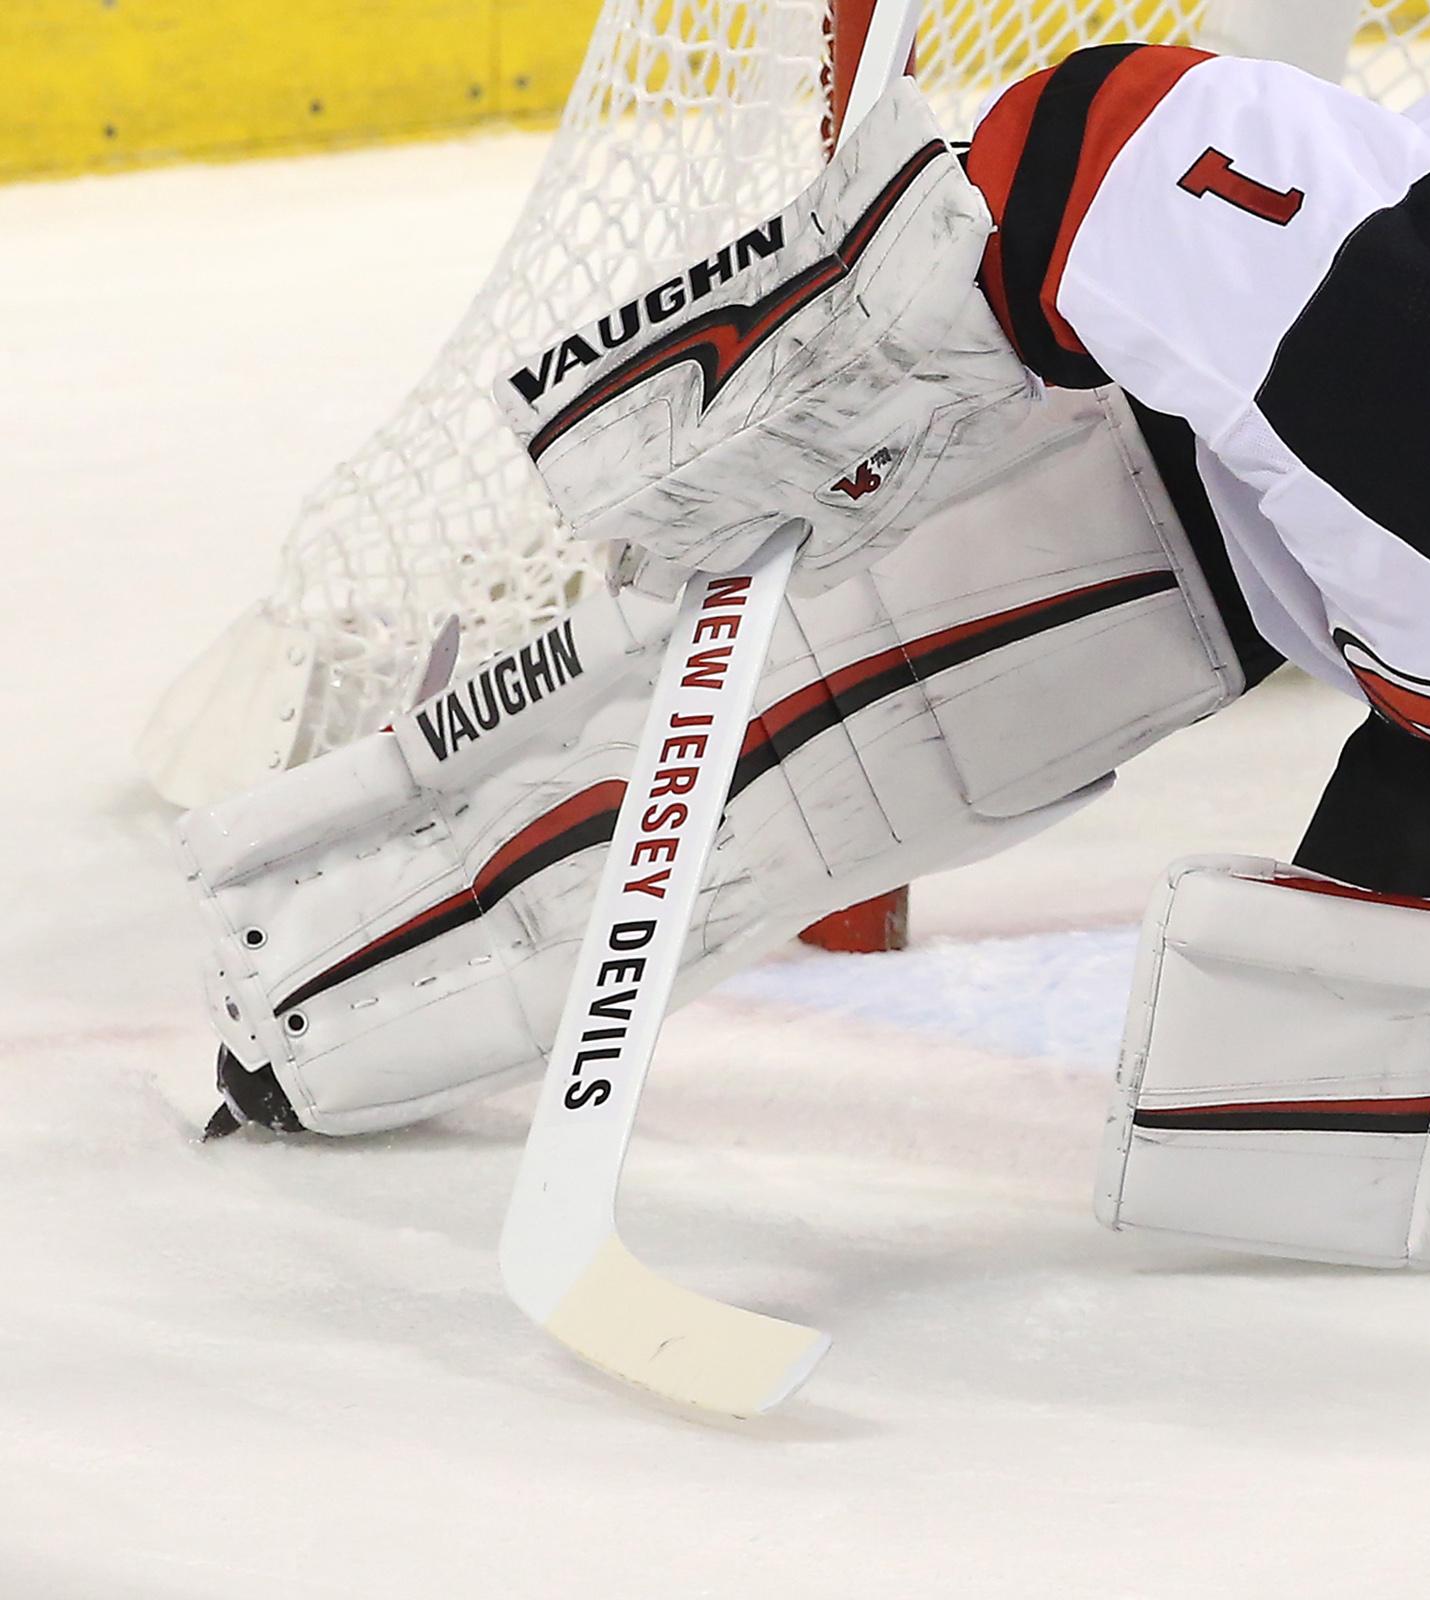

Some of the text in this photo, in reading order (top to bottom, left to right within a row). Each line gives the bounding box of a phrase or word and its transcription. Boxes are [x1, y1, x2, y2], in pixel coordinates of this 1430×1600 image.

[1177, 146, 1305, 226] 1
[507, 214, 786, 405] VAUGHN
[415, 618, 584, 762] VAUGHN
[563, 575, 753, 1111] NEW JERSEY DEVILS
